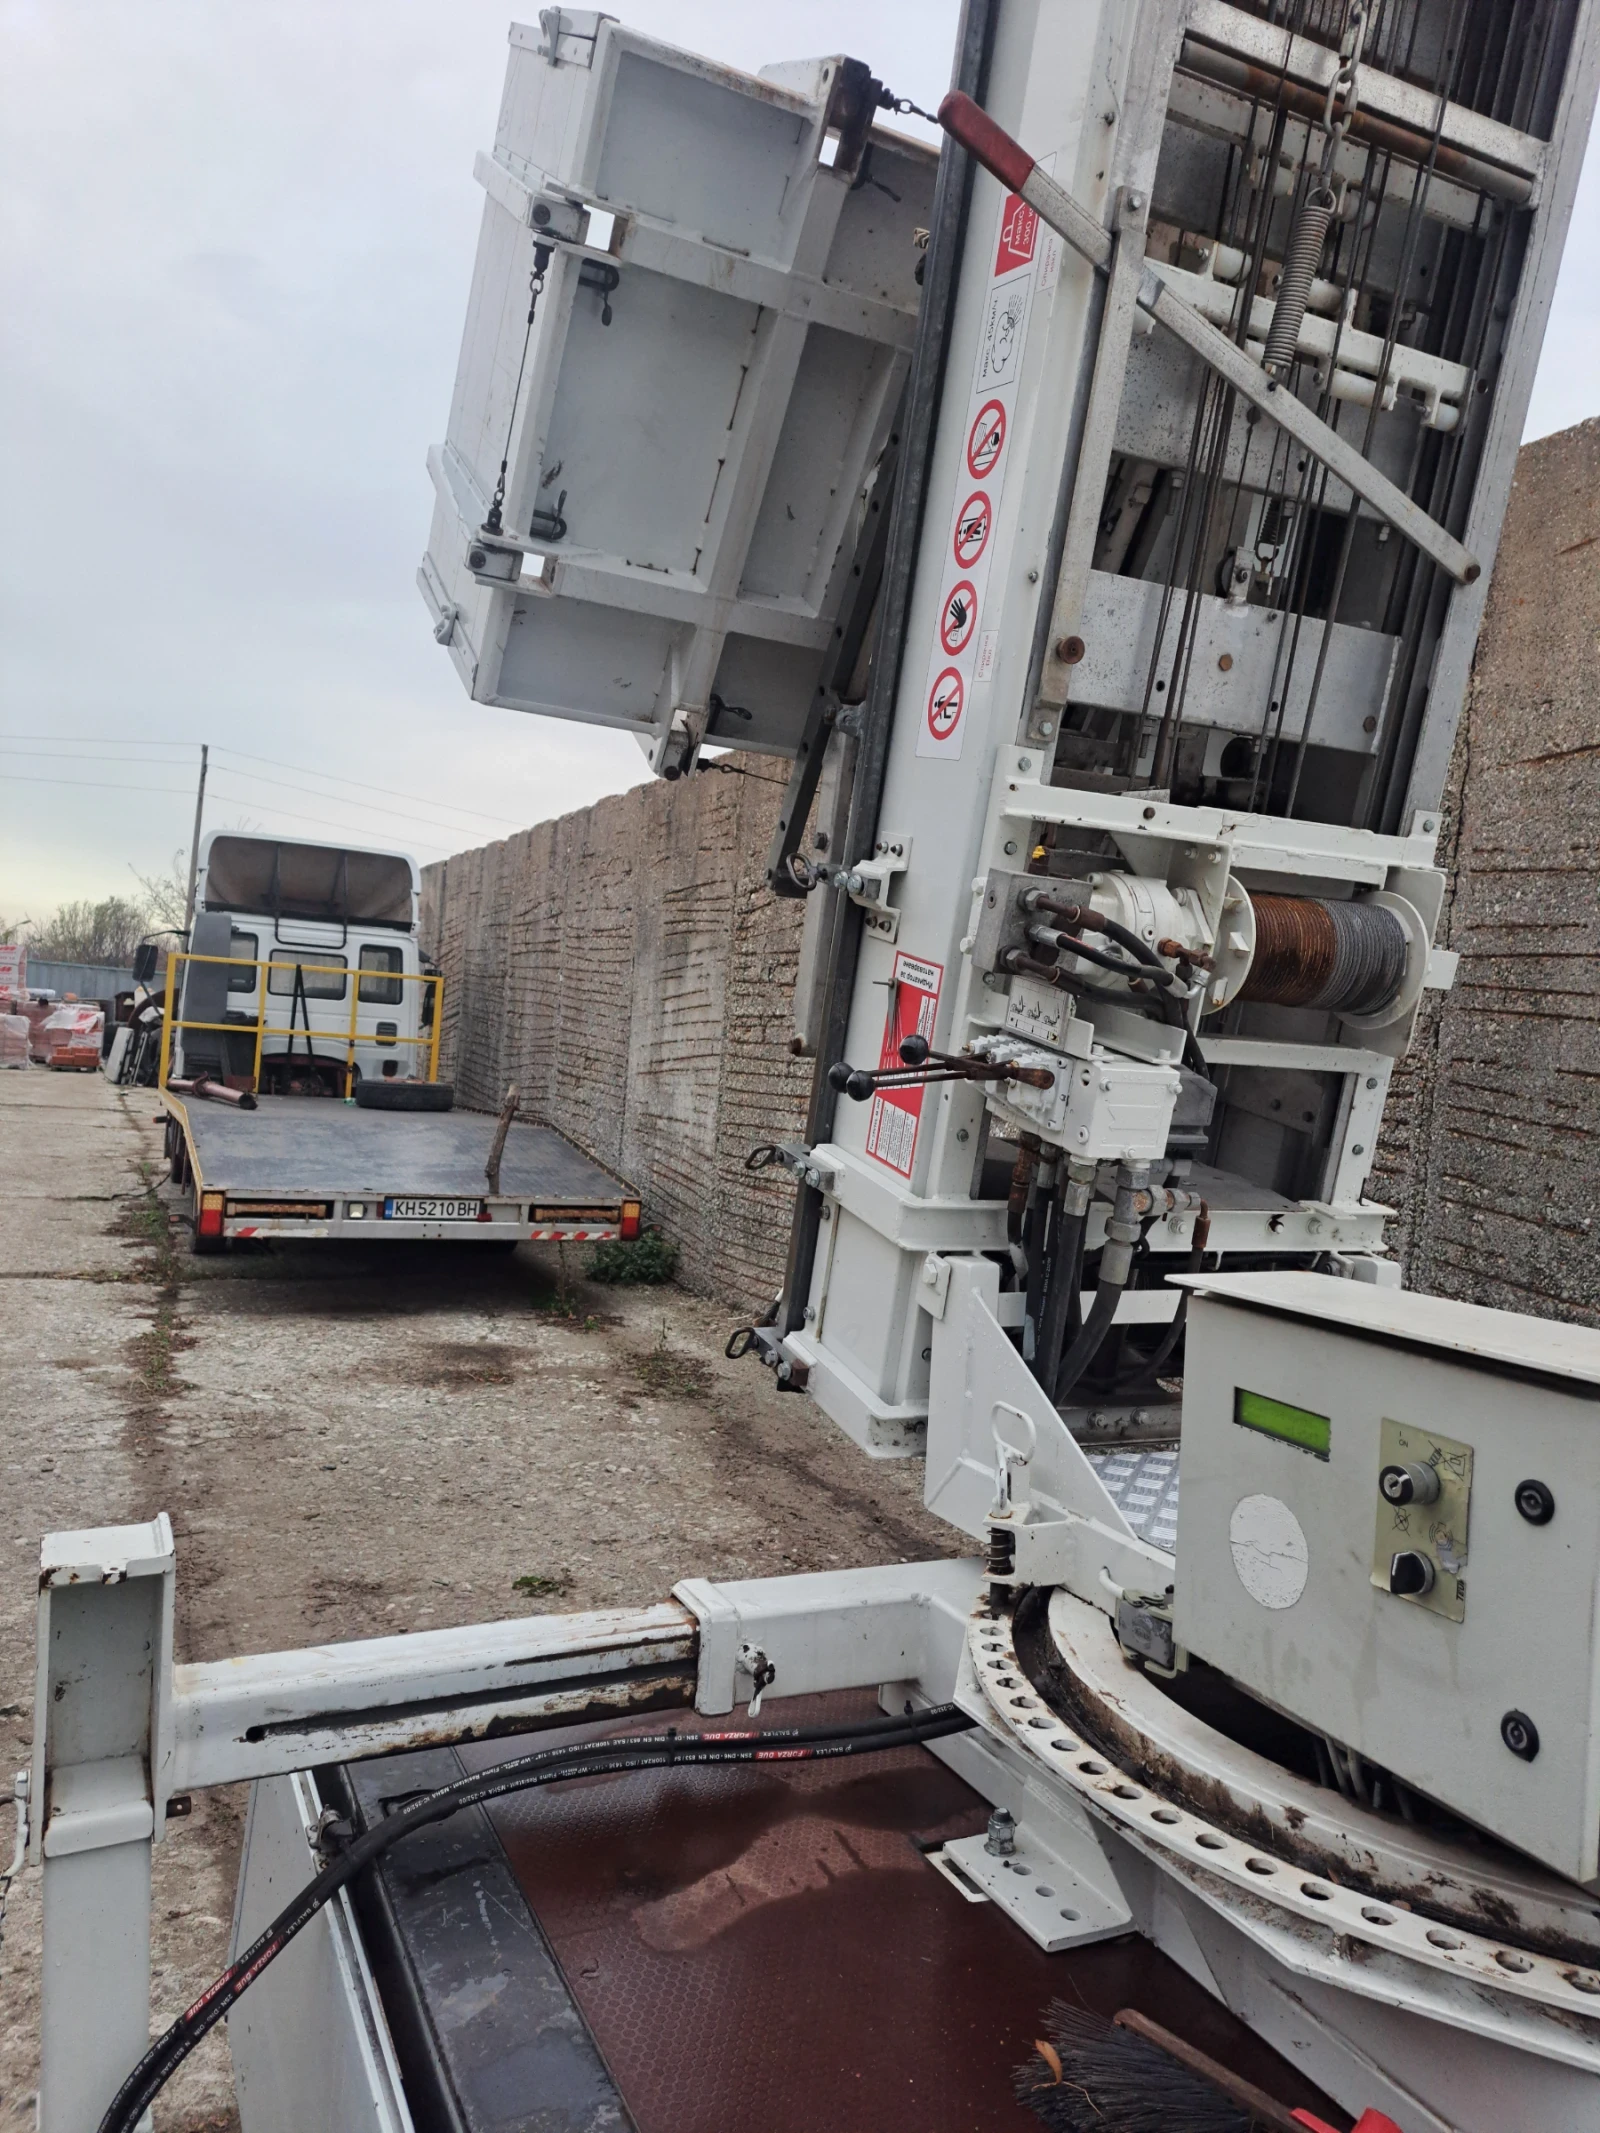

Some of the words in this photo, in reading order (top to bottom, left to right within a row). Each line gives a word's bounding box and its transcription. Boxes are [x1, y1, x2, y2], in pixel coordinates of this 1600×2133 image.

[1023, 221, 1032, 245] 300
[395, 1201, 416, 1215] KH
[418, 1201, 455, 1216] 5210
[457, 1202, 478, 1216] BH
[1399, 1439, 1409, 1448] ON
[778, 1750, 803, 1758] FORZA
[453, 1774, 480, 1788] Resistant
[482, 1767, 500, 1777] Flame
[285, 1907, 312, 1935] BALFLEX
[239, 1936, 266, 1964] BALFLEX
[252, 1944, 278, 1972] FORZA
[204, 1972, 231, 2000] FORZA
[235, 1972, 253, 1991] DUE
[185, 1999, 205, 2019] DUE
